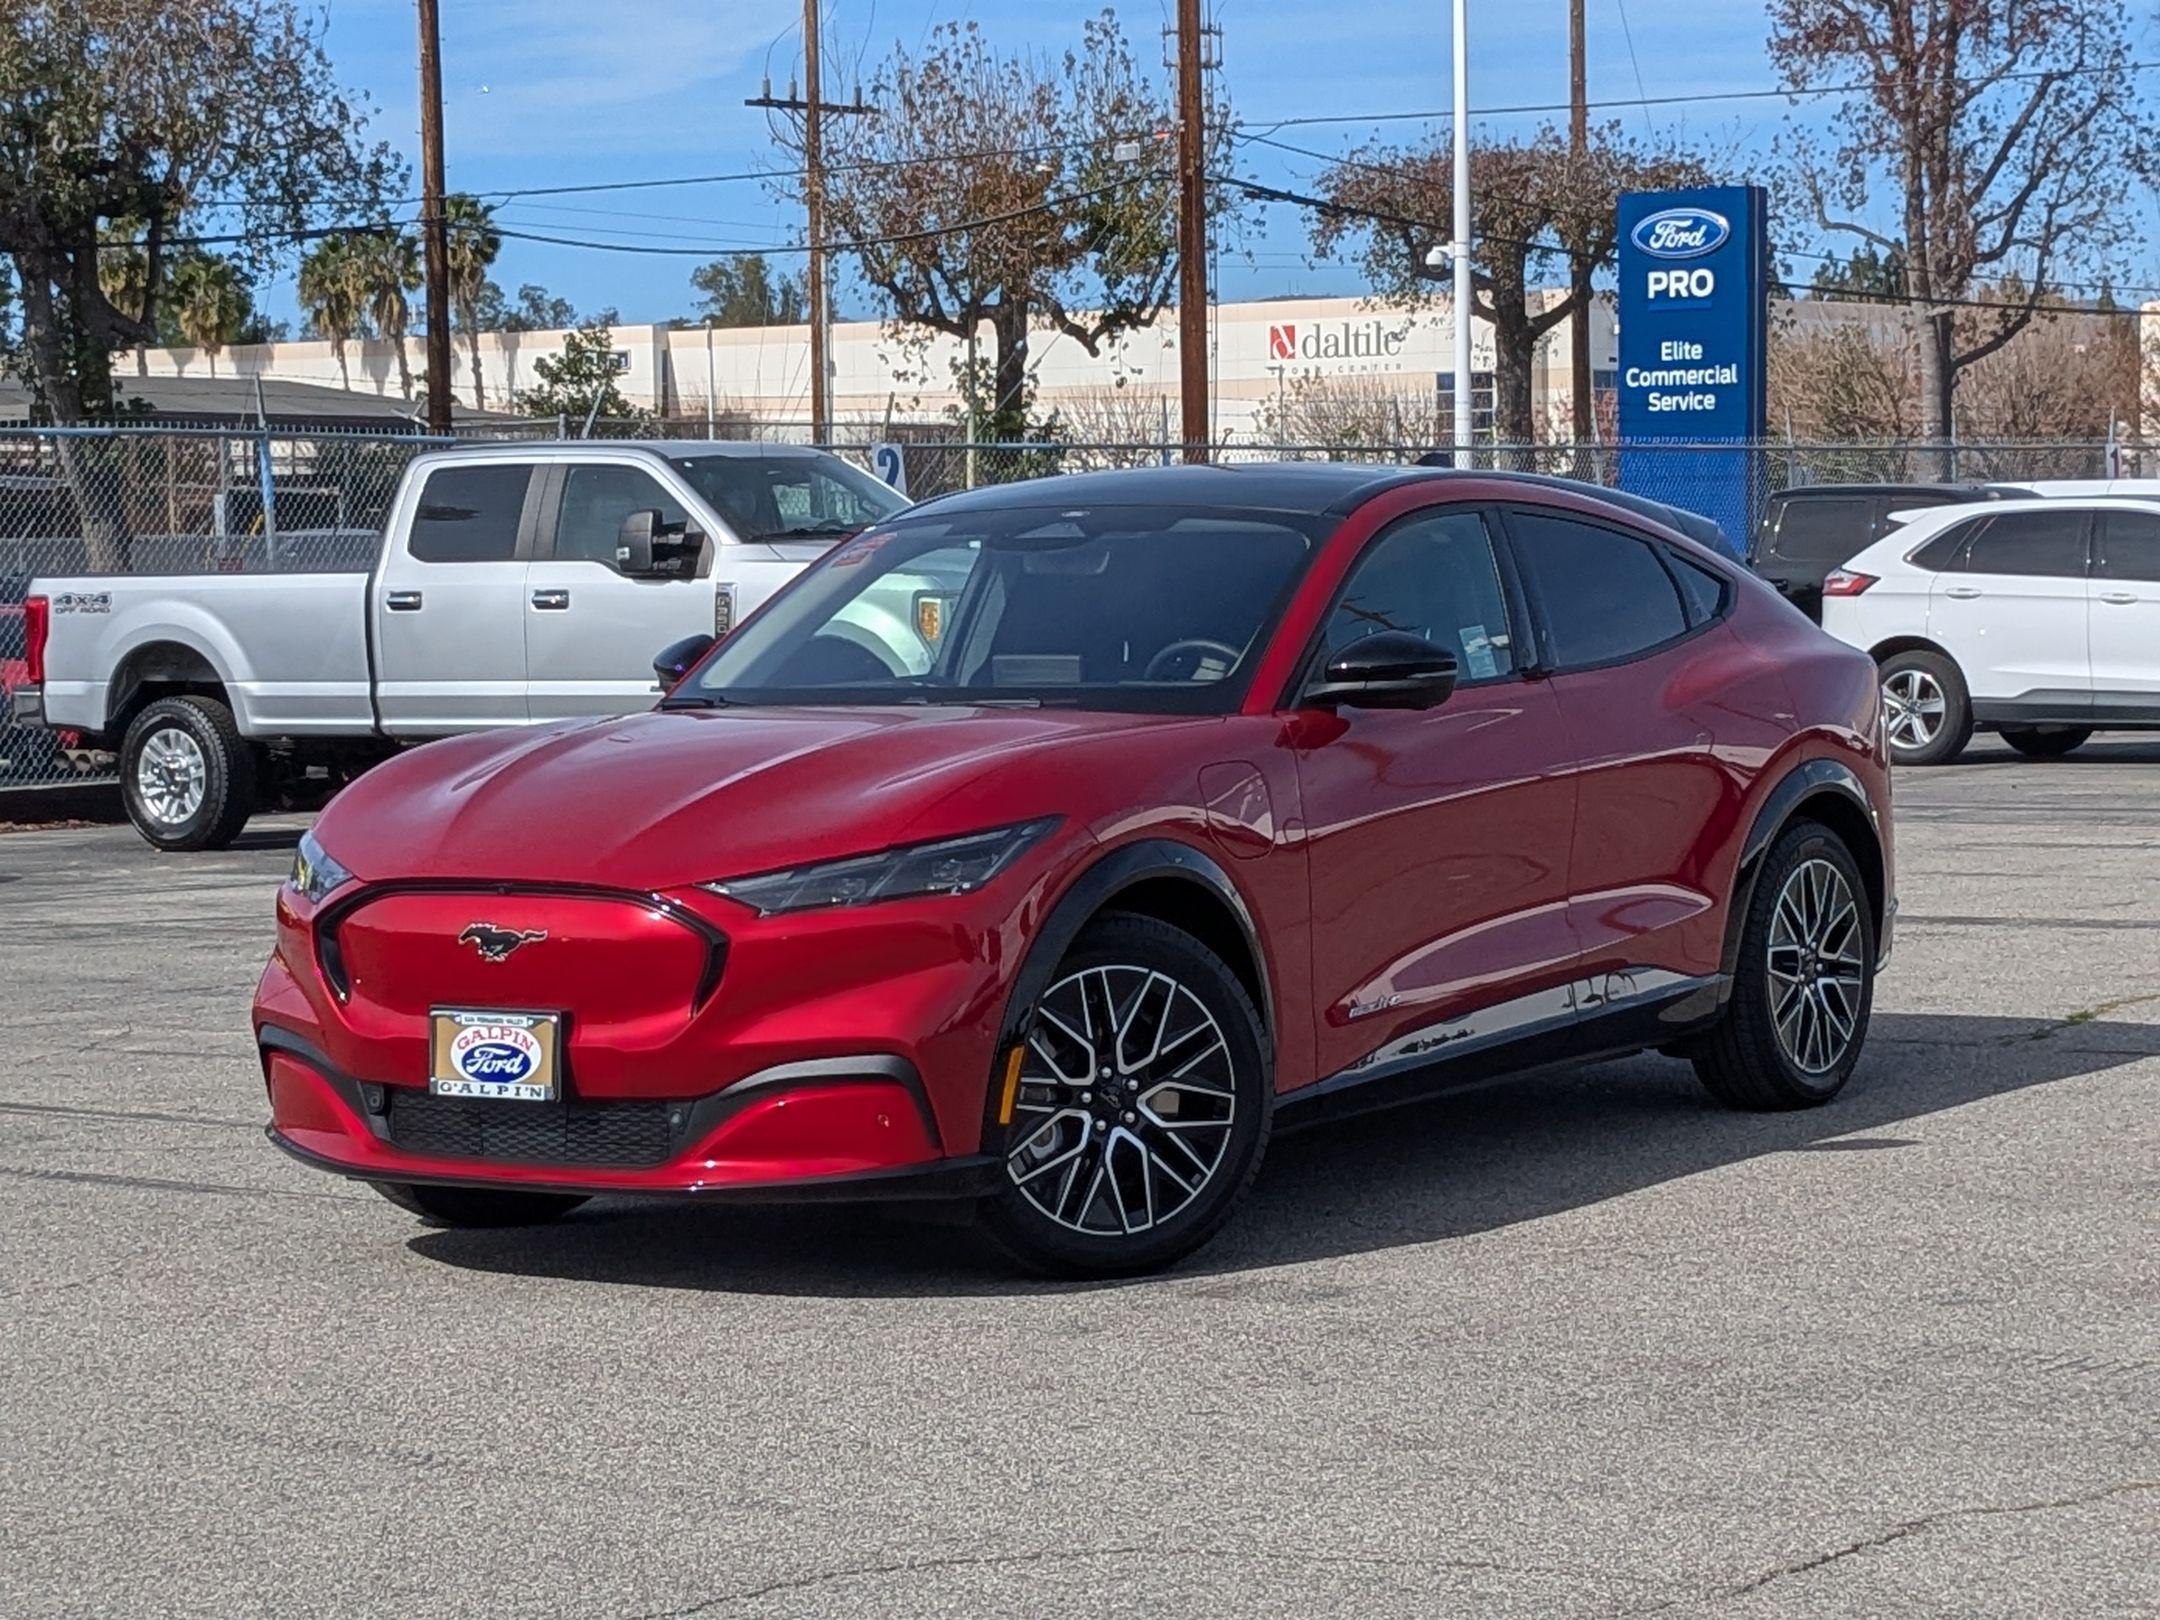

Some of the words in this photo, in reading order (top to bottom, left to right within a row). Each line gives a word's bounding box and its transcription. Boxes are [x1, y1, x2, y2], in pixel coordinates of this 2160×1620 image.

[1649, 219, 1708, 249] Ford
[1647, 268, 1715, 299] PRO
[1301, 320, 1402, 360] daltile
[1660, 341, 1703, 361] Elite
[1625, 363, 1738, 388] Commercial
[1647, 390, 1716, 412] Service
[877, 447, 899, 487] 2
[456, 1025, 534, 1051] GALPIN
[465, 1046, 525, 1074] Ford
[439, 1081, 543, 1098] GALPIN
